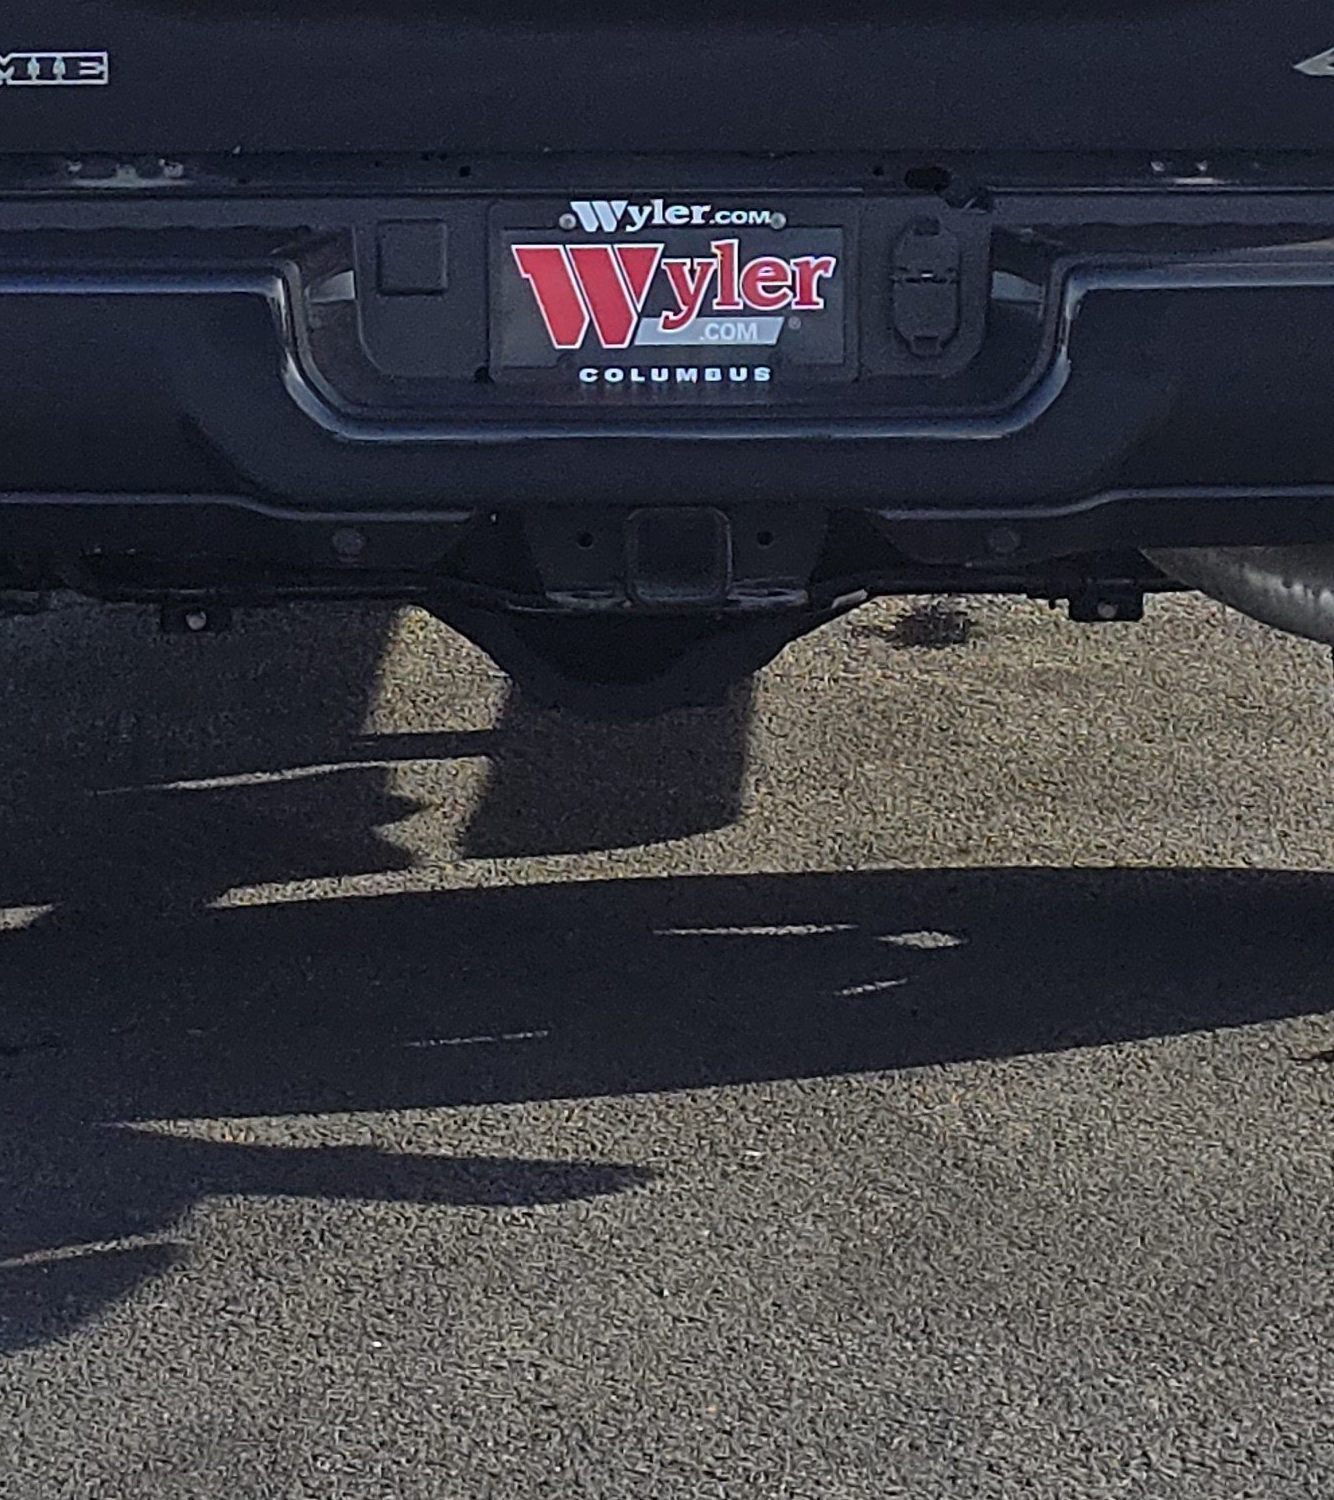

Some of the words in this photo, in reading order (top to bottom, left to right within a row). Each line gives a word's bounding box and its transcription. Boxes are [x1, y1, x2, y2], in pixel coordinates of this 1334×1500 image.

[511, 238, 837, 350] Wyler
[699, 322, 758, 341] .COM
[578, 367, 772, 383] COLUMBUS
